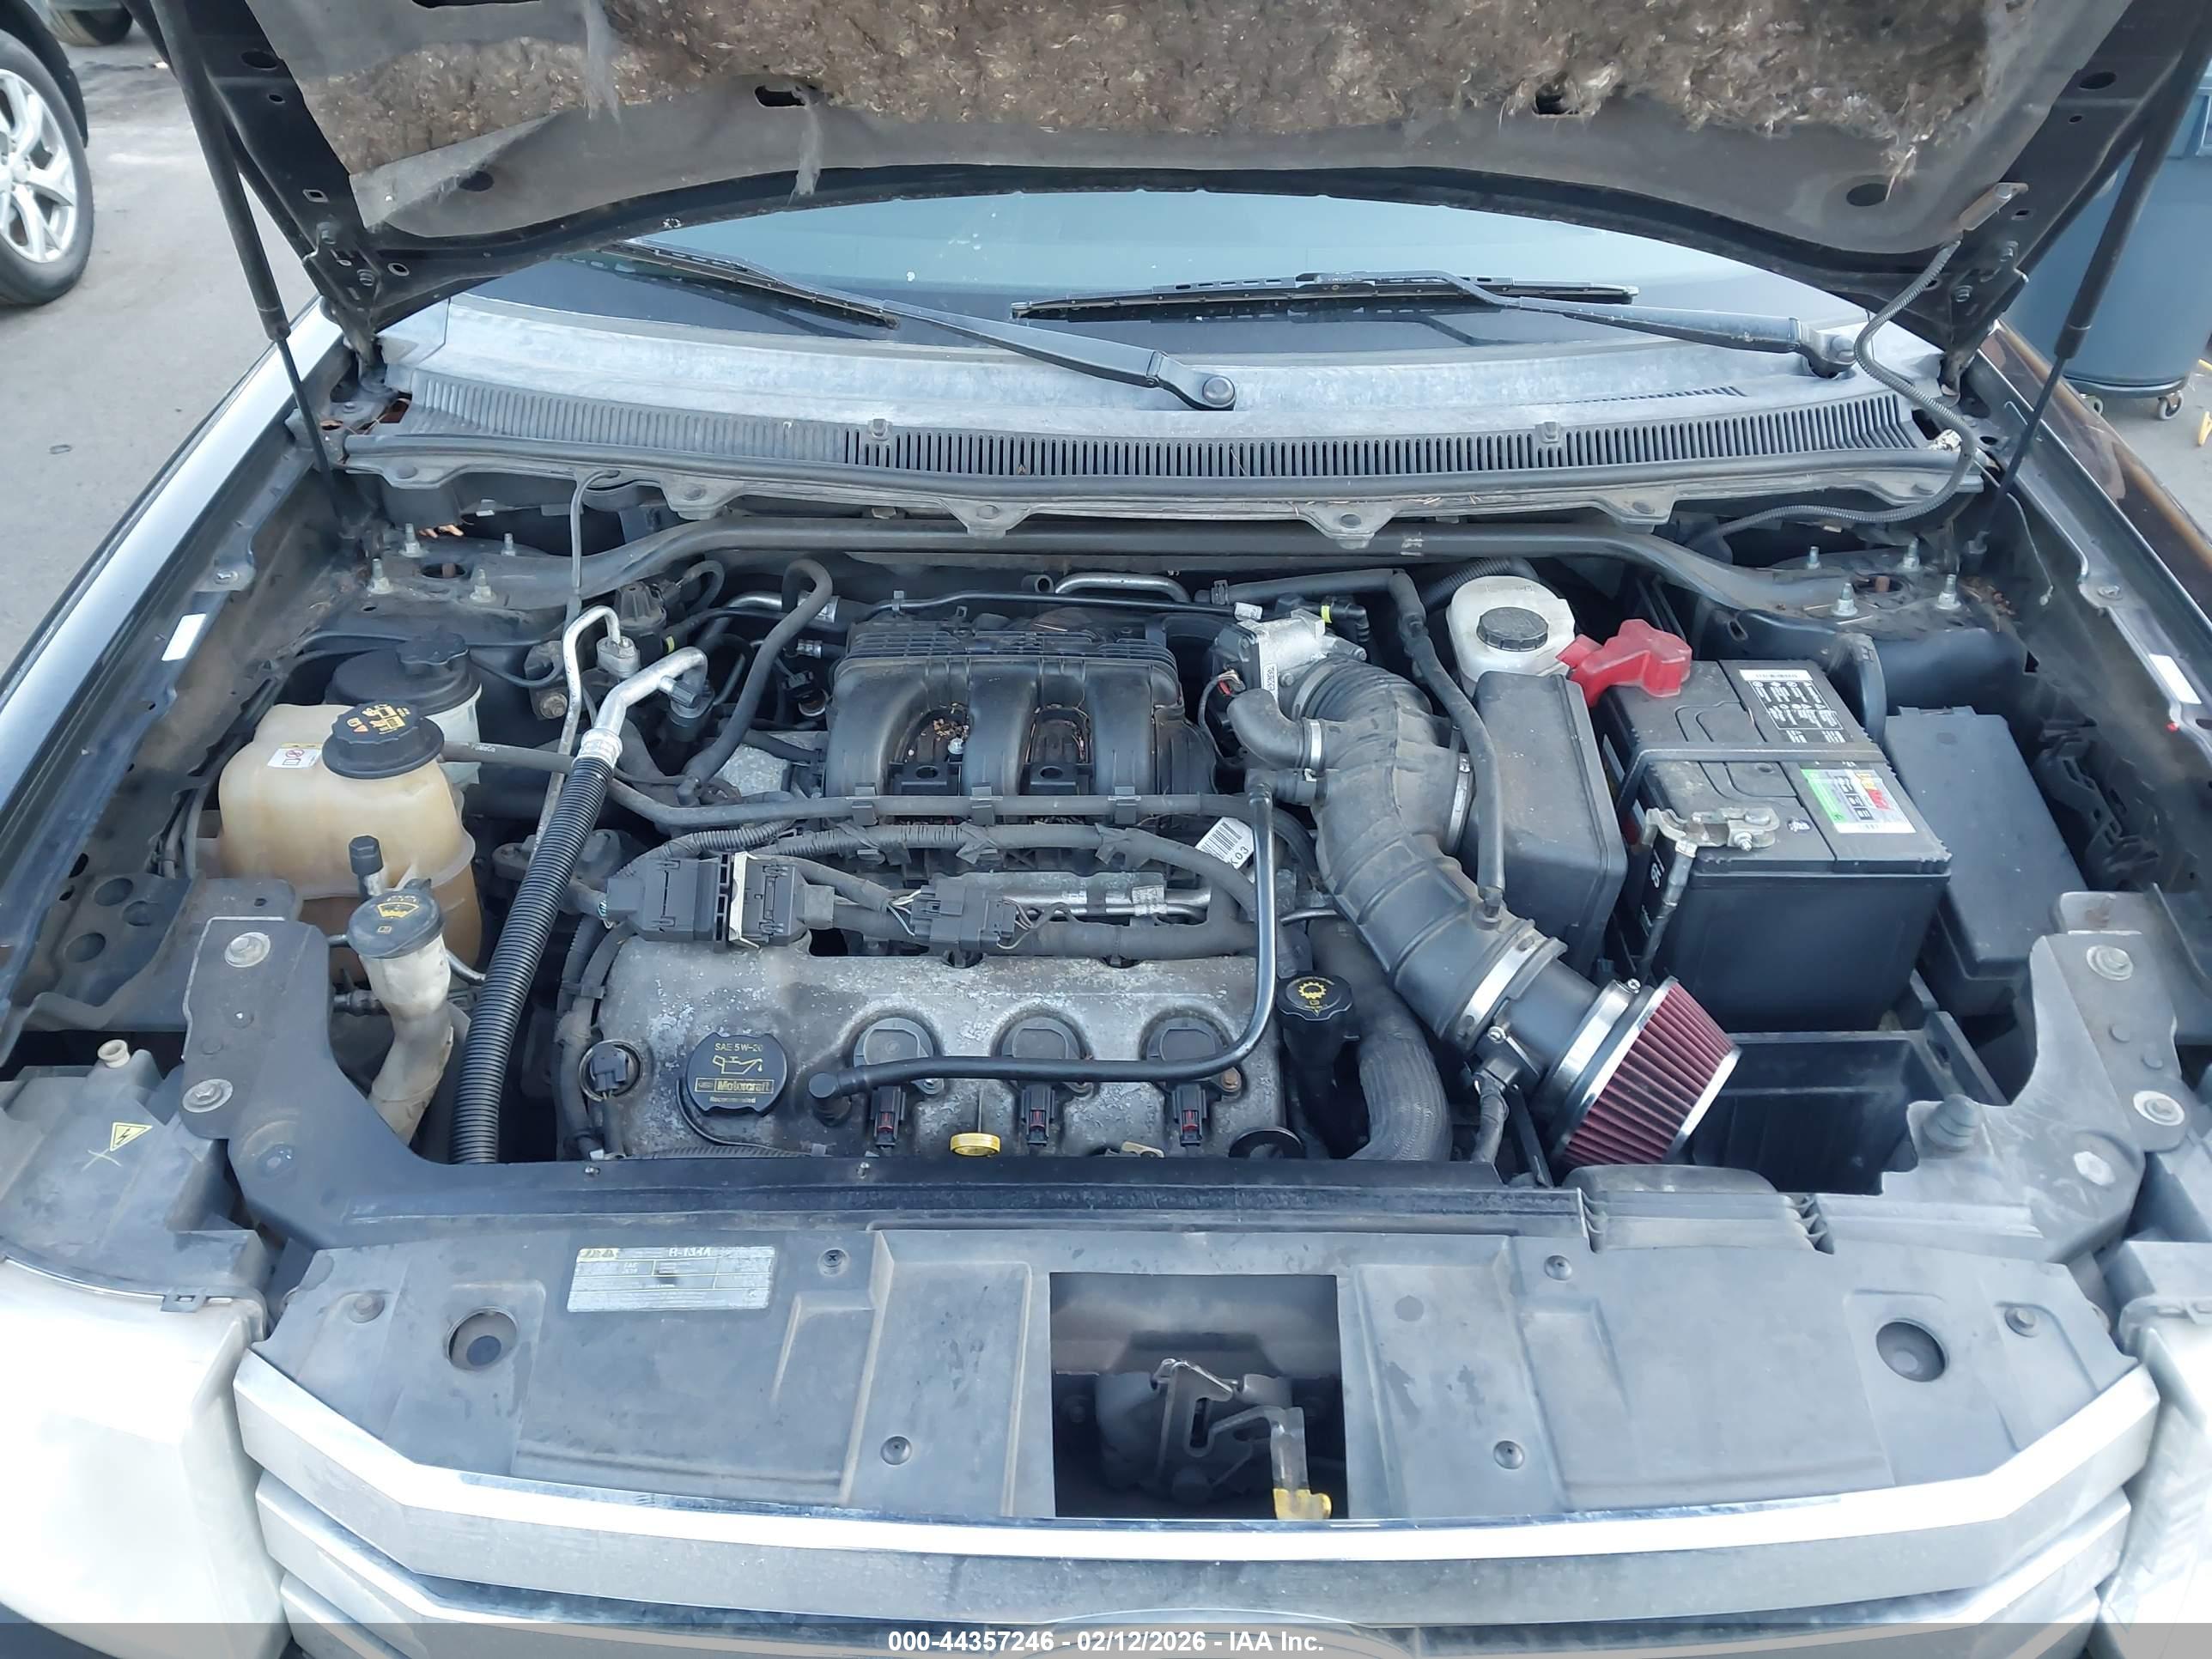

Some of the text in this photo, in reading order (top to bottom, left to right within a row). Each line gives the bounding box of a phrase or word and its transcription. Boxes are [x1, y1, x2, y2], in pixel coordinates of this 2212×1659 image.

[714, 1042, 763, 1052] SAE 5W-20
[717, 1080, 769, 1092] Motorcraft
